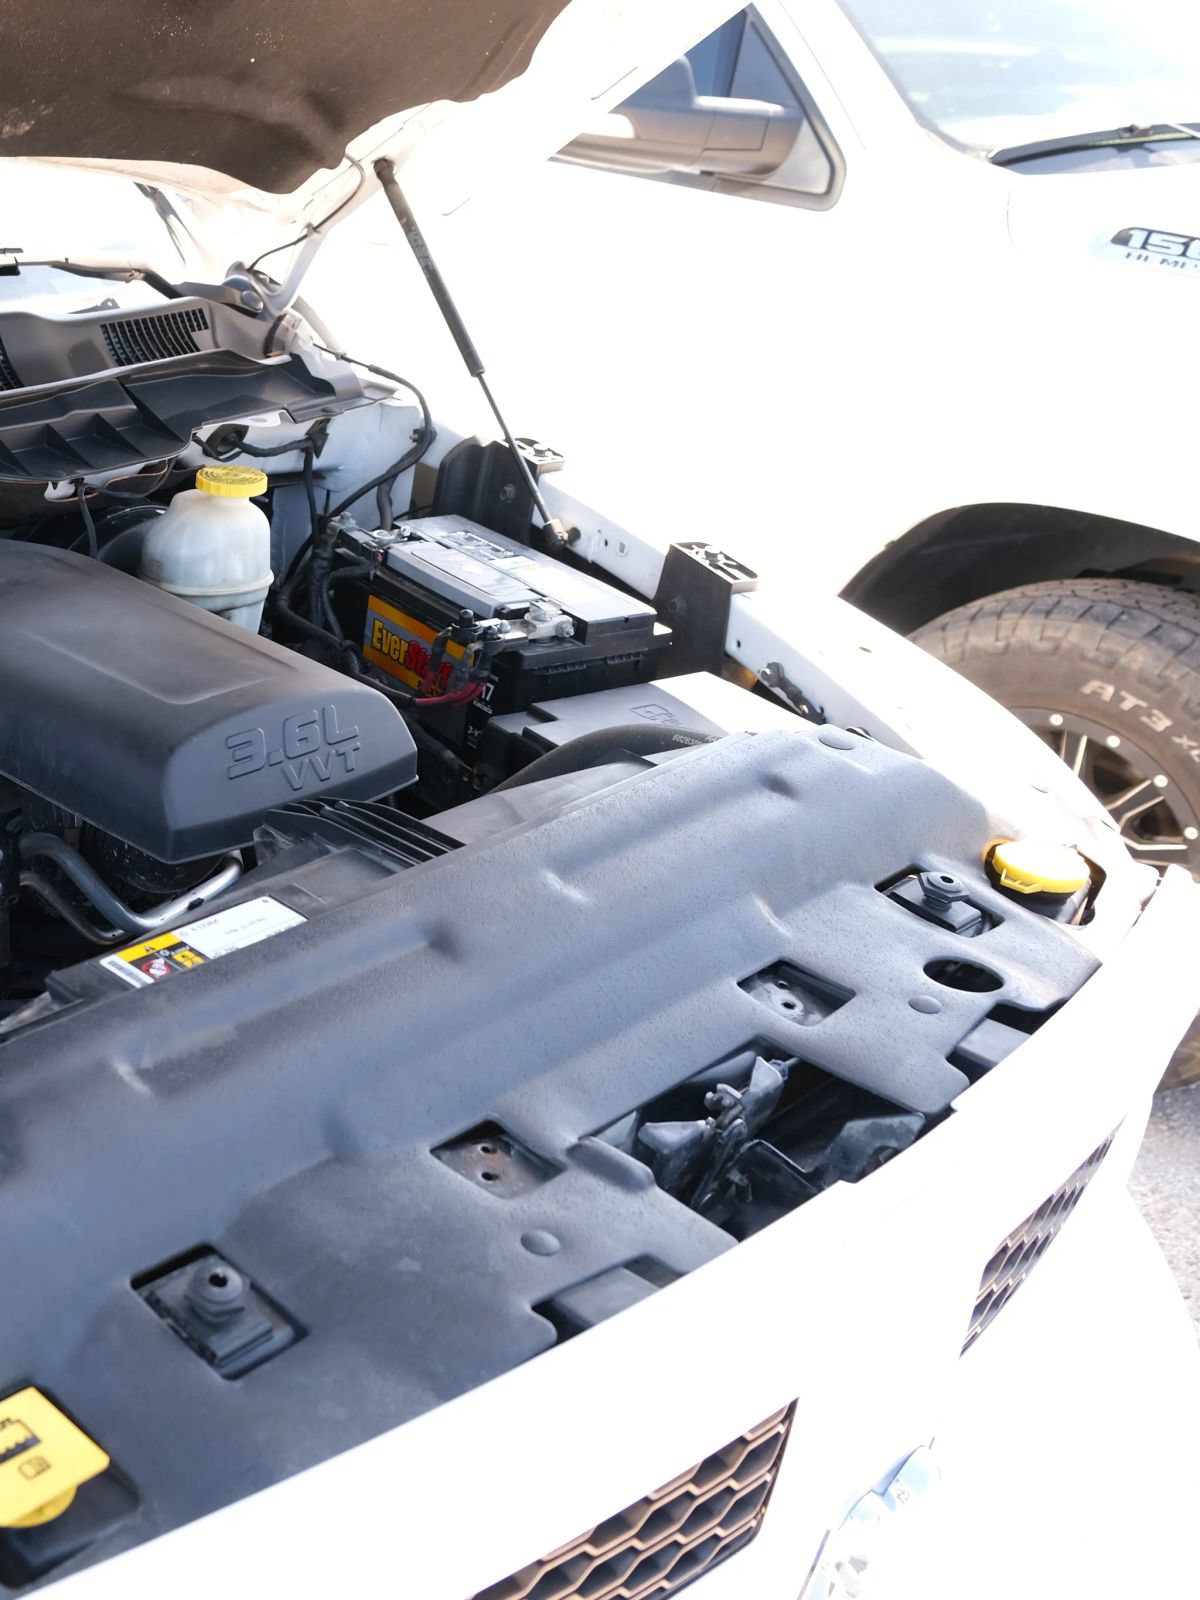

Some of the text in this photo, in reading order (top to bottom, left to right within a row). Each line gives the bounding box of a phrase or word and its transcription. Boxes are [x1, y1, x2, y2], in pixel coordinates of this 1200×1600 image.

[371, 619, 454, 690] EverStt
[1080, 680, 1173, 732] AT3
[225, 704, 359, 780] 3.6L
[281, 742, 360, 791] VVT
